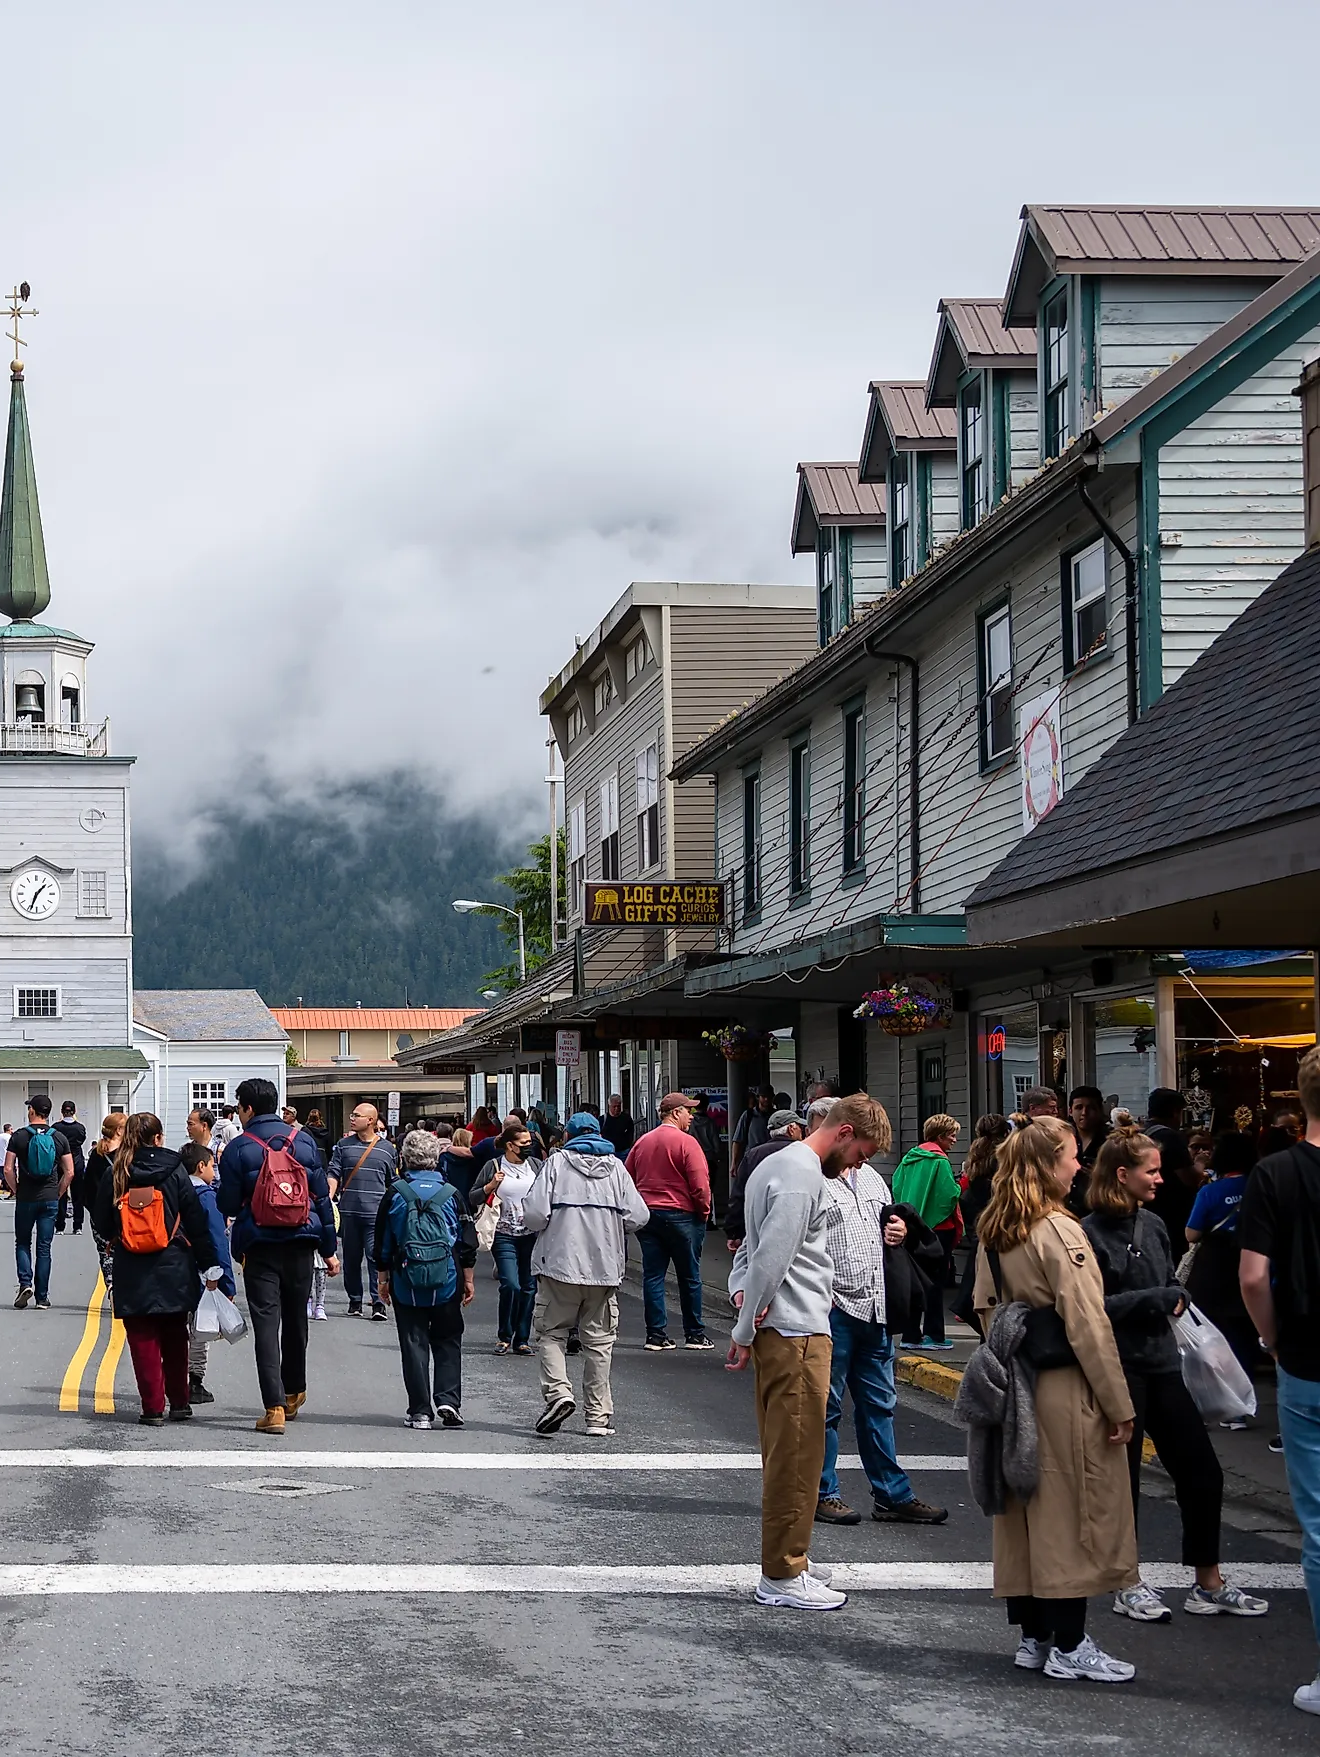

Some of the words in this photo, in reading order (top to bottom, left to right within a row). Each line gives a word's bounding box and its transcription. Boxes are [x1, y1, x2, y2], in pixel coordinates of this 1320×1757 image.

[623, 886, 654, 904] LOG
[660, 886, 719, 904] CACHE
[625, 905, 677, 922] GIFTS
[680, 913, 720, 923] JEWELRY
[988, 1032, 1006, 1053] OPEN
